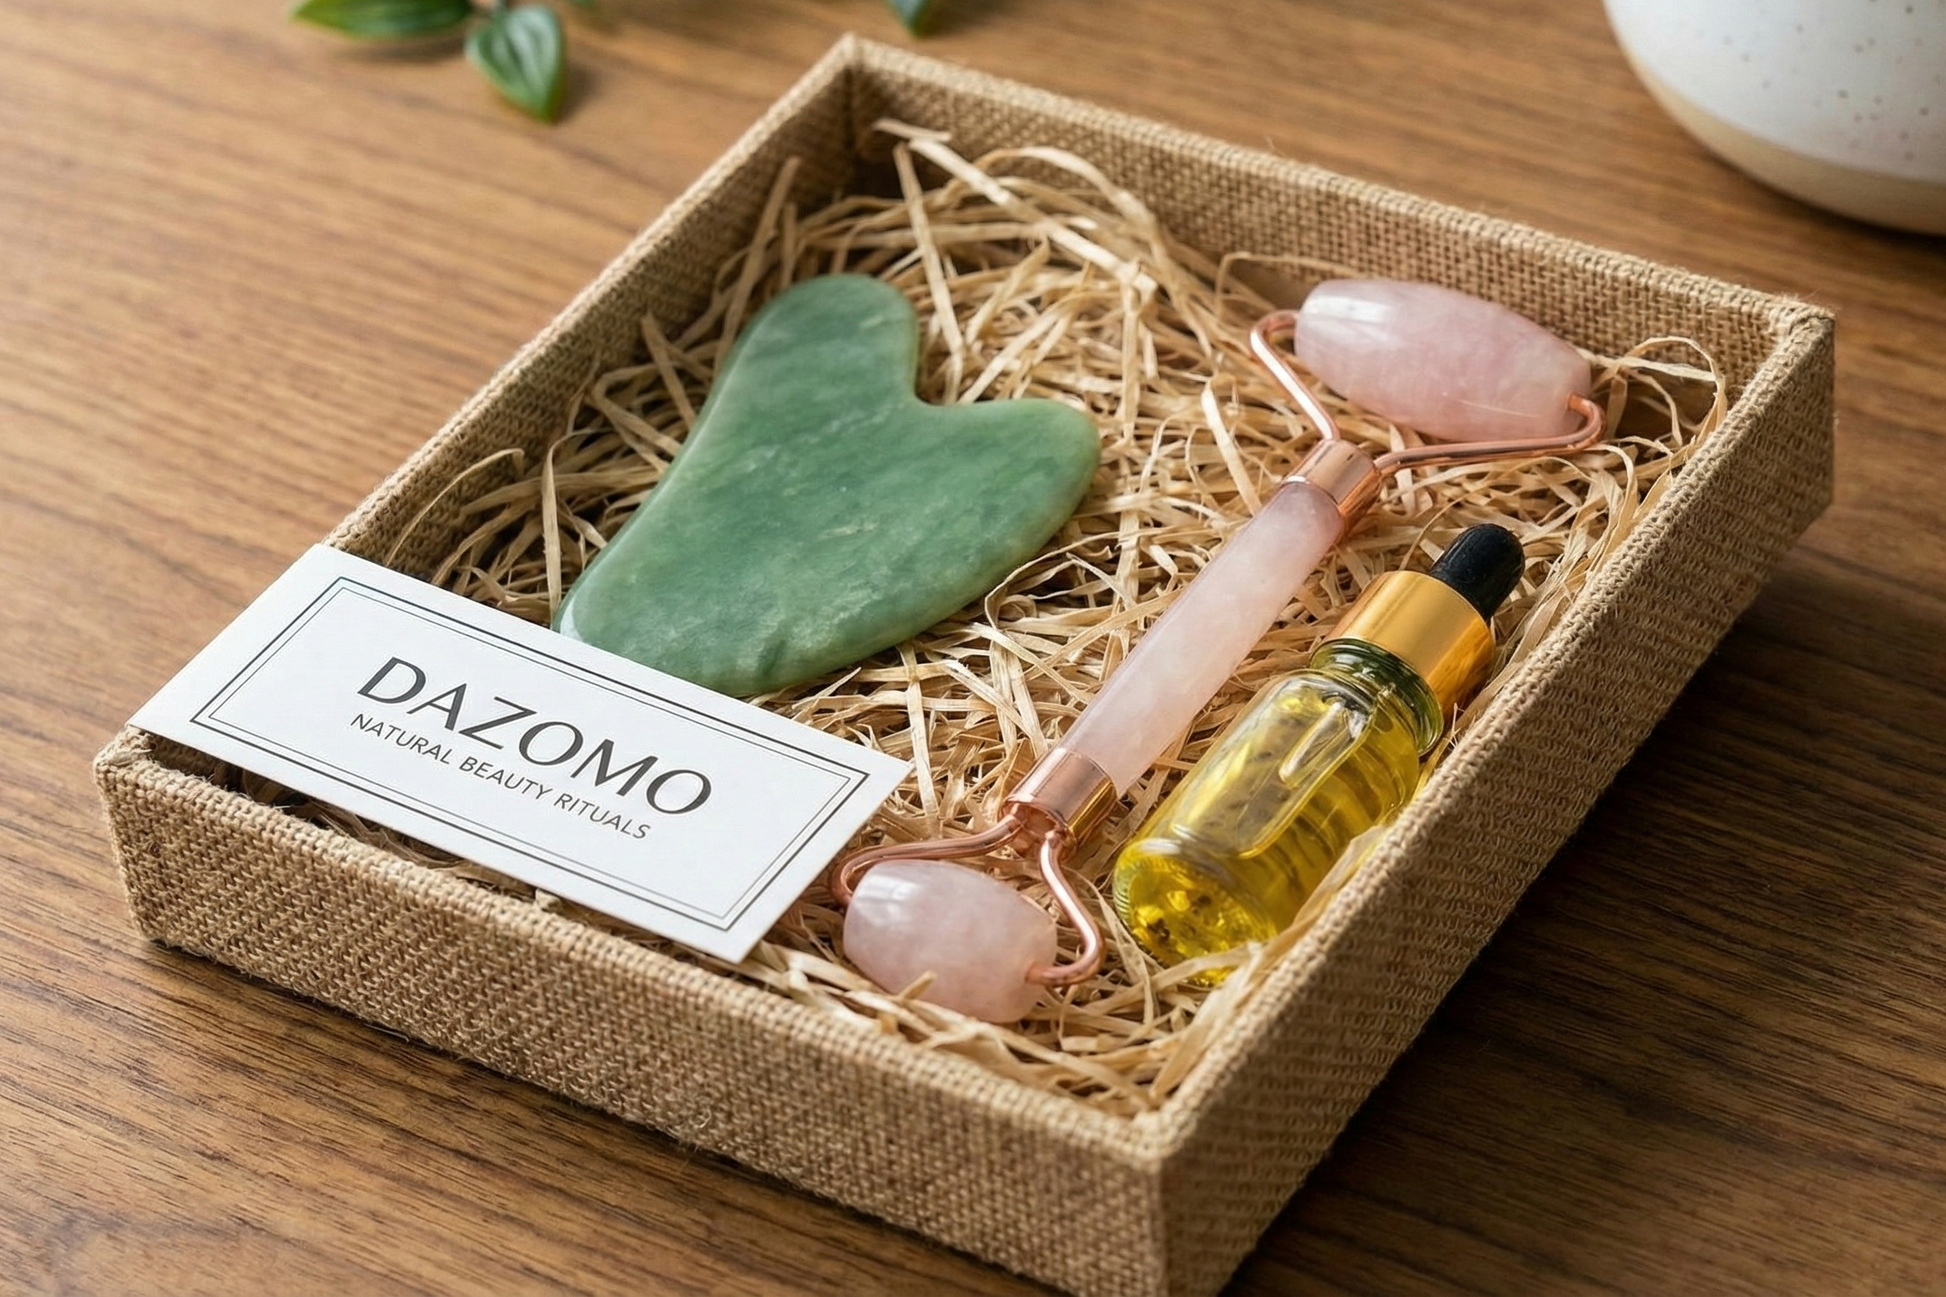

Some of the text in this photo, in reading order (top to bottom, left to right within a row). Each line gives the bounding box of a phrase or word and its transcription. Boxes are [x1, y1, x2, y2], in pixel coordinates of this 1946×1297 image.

[350, 713, 651, 840] NATURAL BEAUTY RITUALS
[357, 656, 712, 815] DAZOMO
